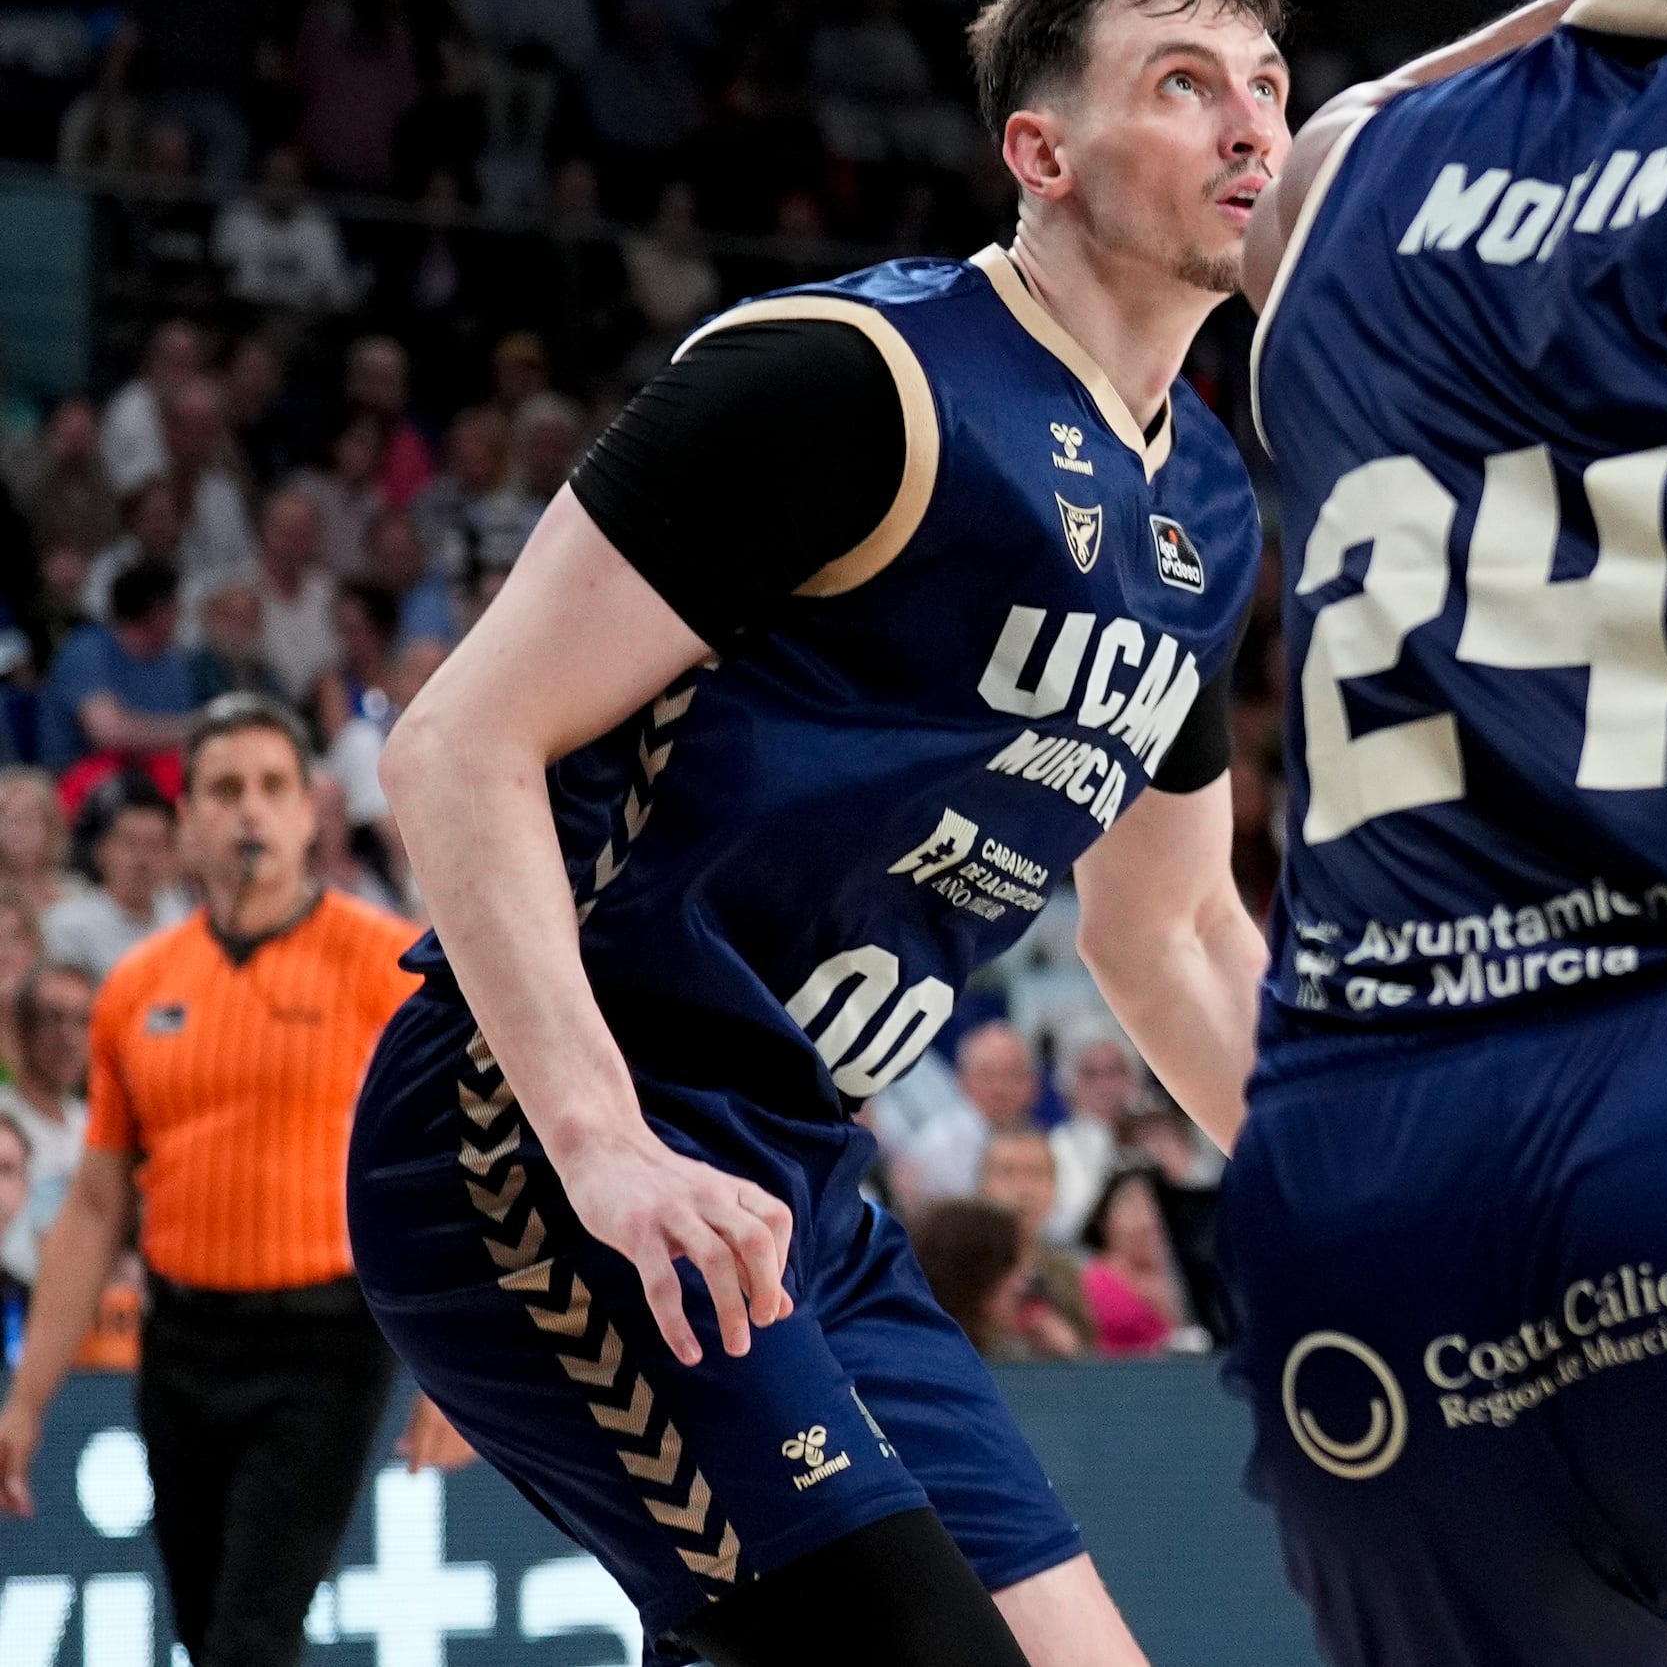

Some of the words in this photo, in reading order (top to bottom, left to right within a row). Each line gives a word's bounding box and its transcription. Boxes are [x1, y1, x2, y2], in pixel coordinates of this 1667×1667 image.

[1052, 451, 1094, 477] hummel
[977, 604, 1200, 780] UCAM
[985, 728, 1127, 832] MURCIA
[1426, 945, 1639, 1007] Murcia
[784, 943, 954, 1098] 00
[792, 1450, 852, 1492] hummel
